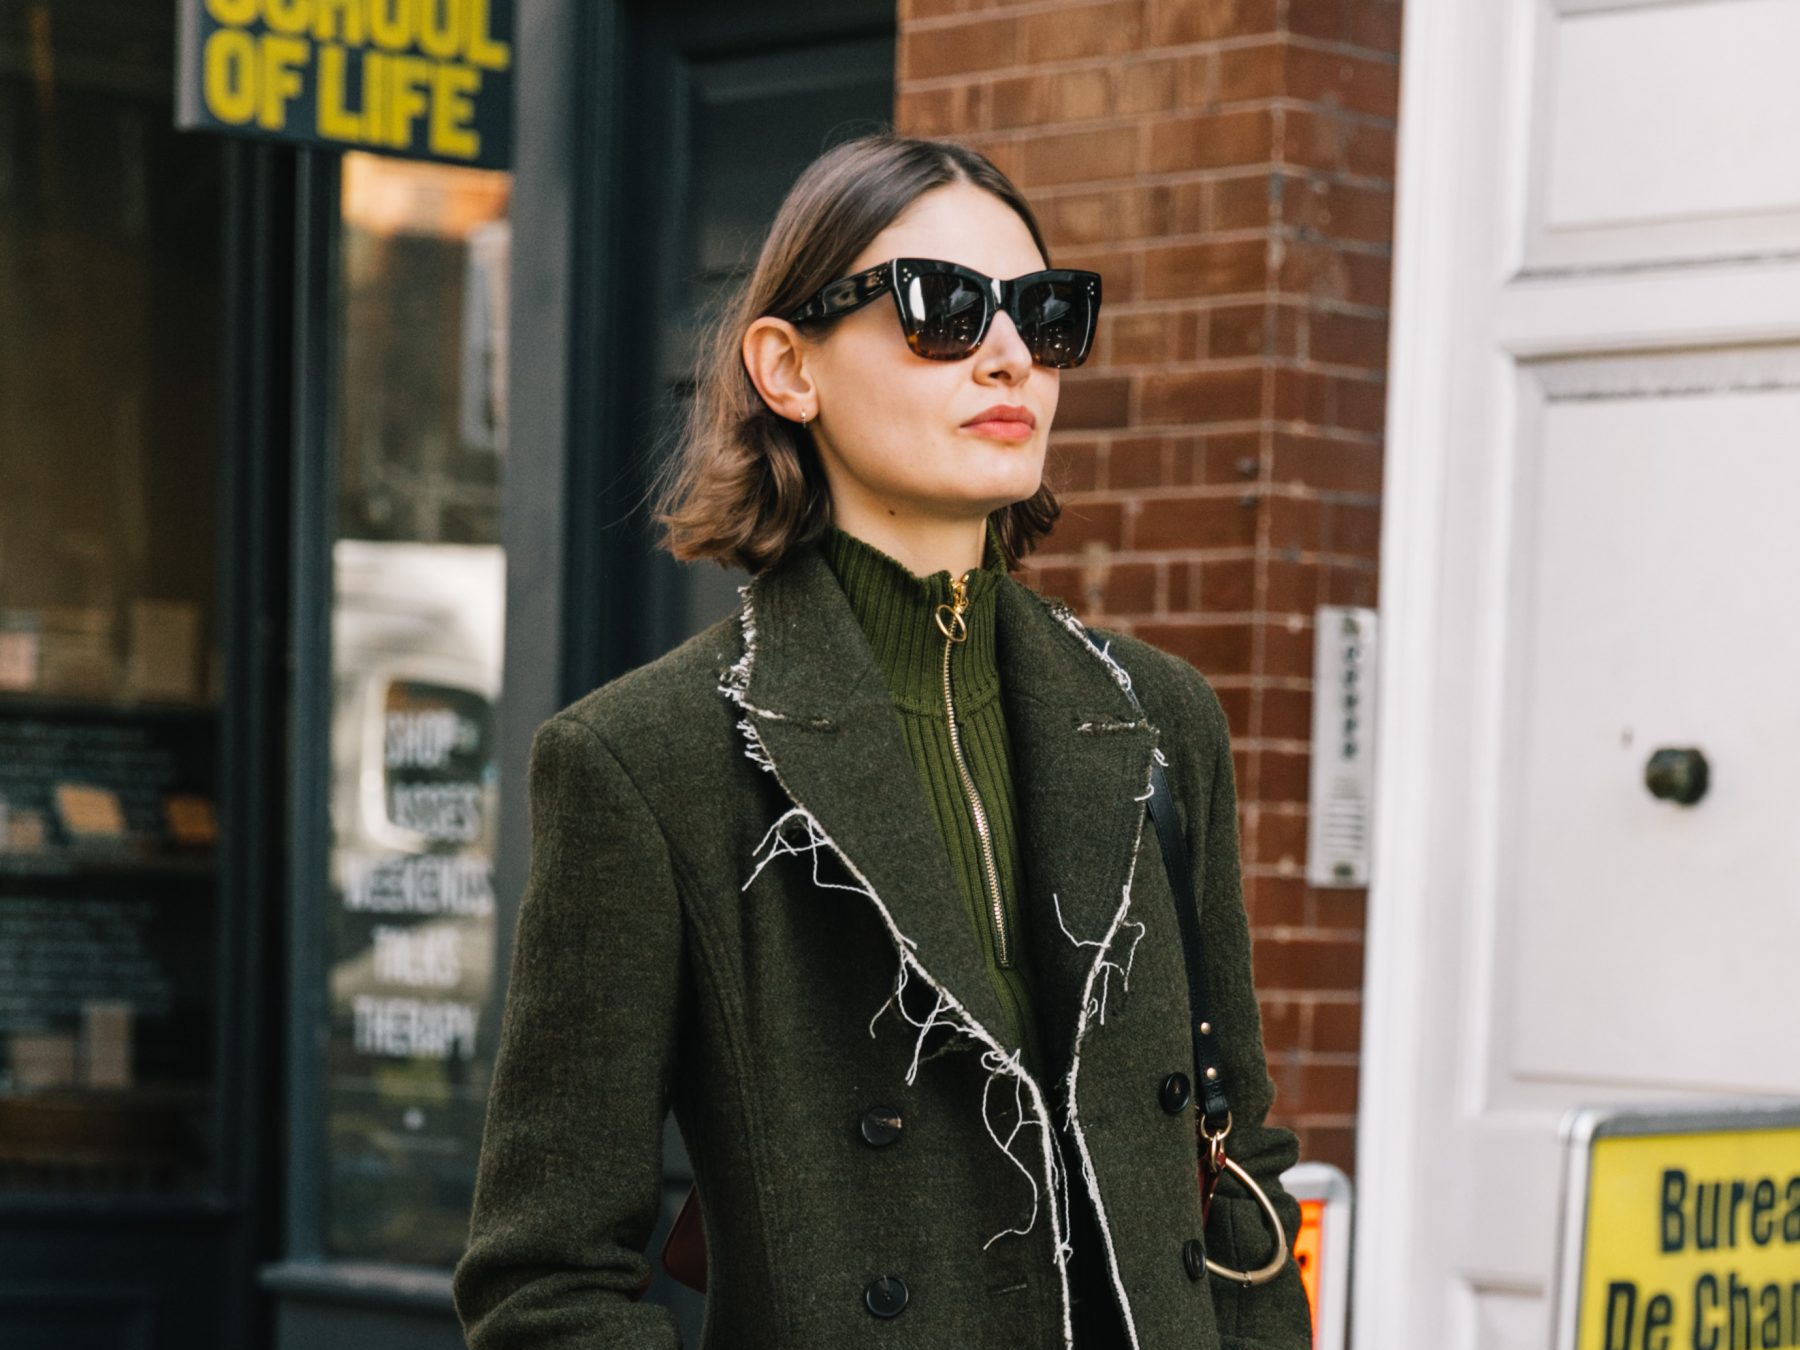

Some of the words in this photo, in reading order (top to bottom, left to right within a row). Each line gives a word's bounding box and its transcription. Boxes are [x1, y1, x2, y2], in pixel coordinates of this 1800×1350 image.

[206, 0, 510, 68] OOL
[204, 28, 310, 131] OF
[316, 45, 482, 158] LIFE
[353, 996, 477, 1060] THERAPY
